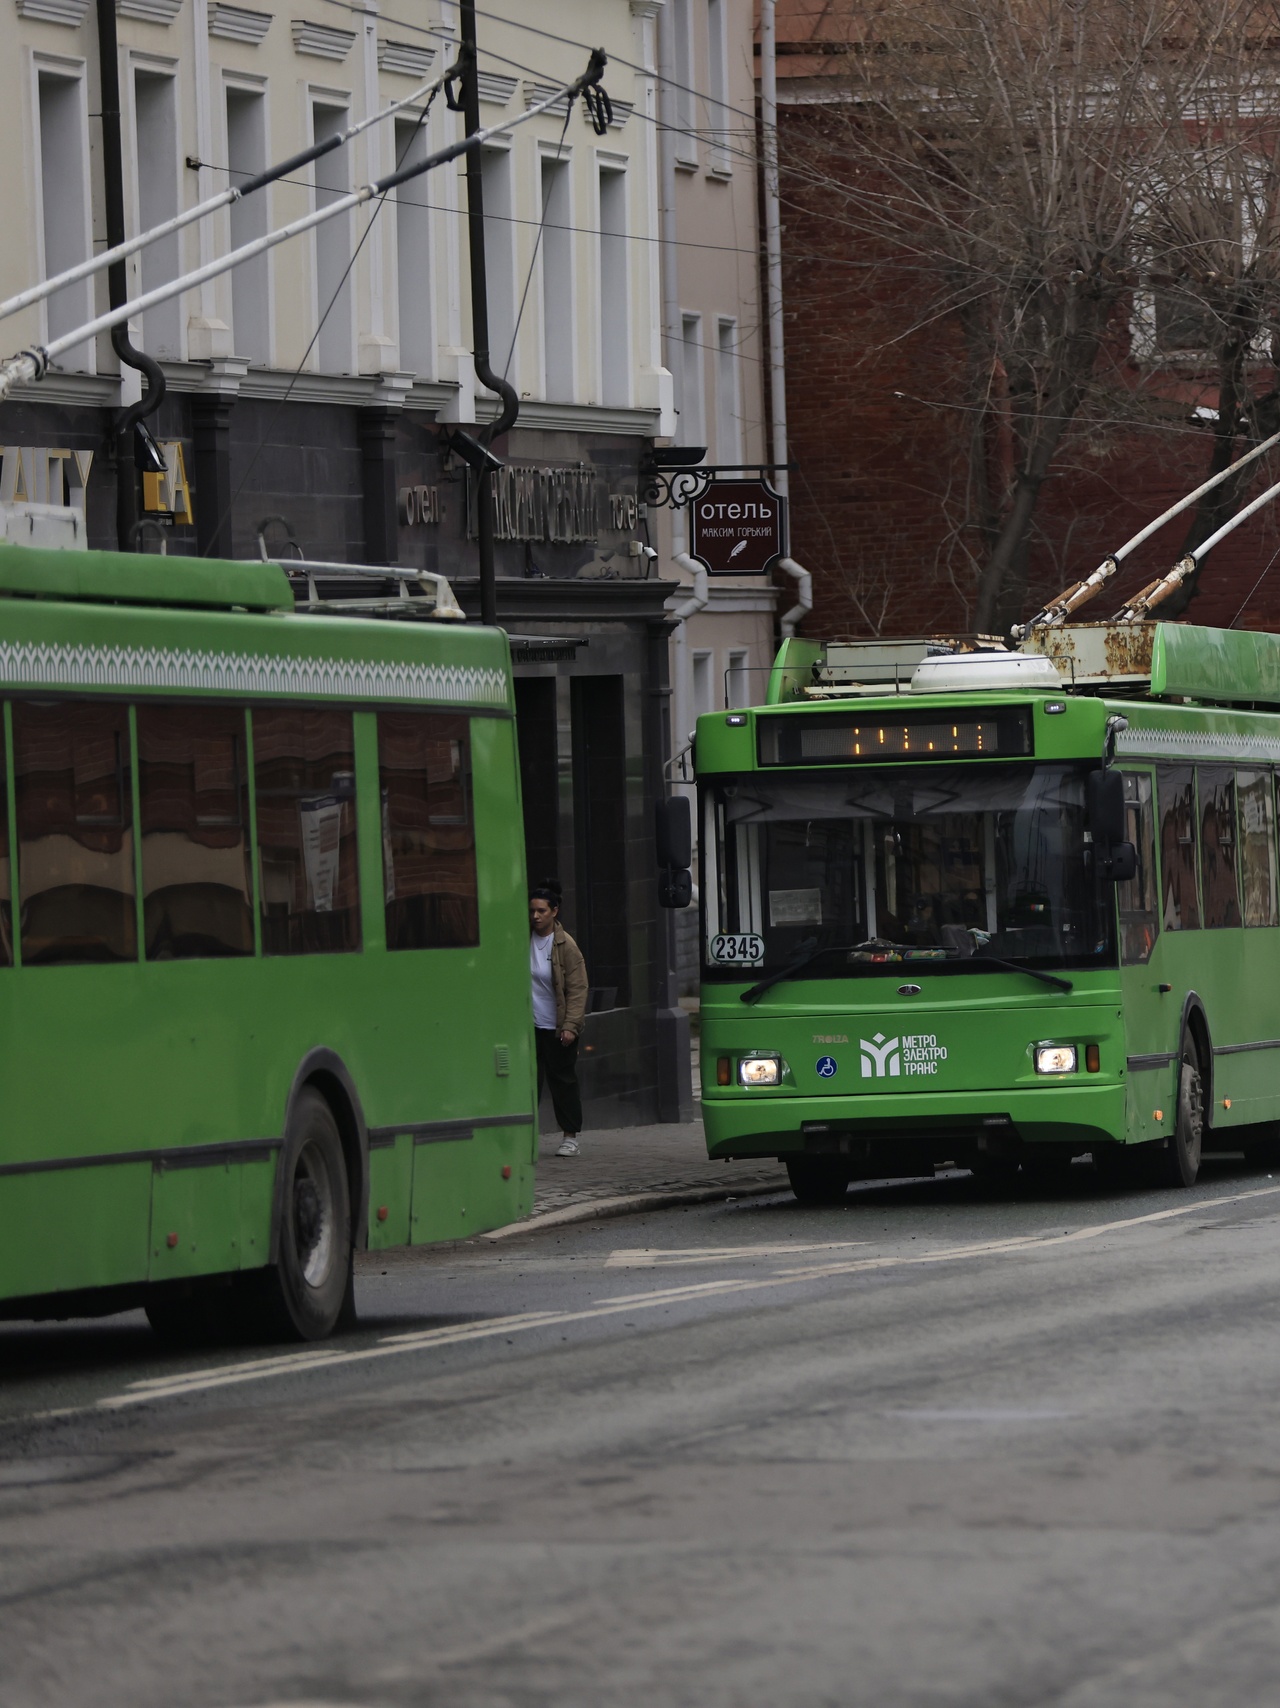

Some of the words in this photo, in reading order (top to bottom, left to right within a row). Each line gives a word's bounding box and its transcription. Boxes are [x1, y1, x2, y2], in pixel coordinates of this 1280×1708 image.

[701, 503, 772, 519] отель
[702, 527, 734, 537] МАКСИМ
[737, 526, 772, 536] ГОРЬКИЙ
[716, 937, 759, 959] 2345
[902, 1035, 936, 1049] МЕТРО
[903, 1047, 947, 1062] ЭЛЕКТРО
[904, 1062, 938, 1076] ТРАНС
